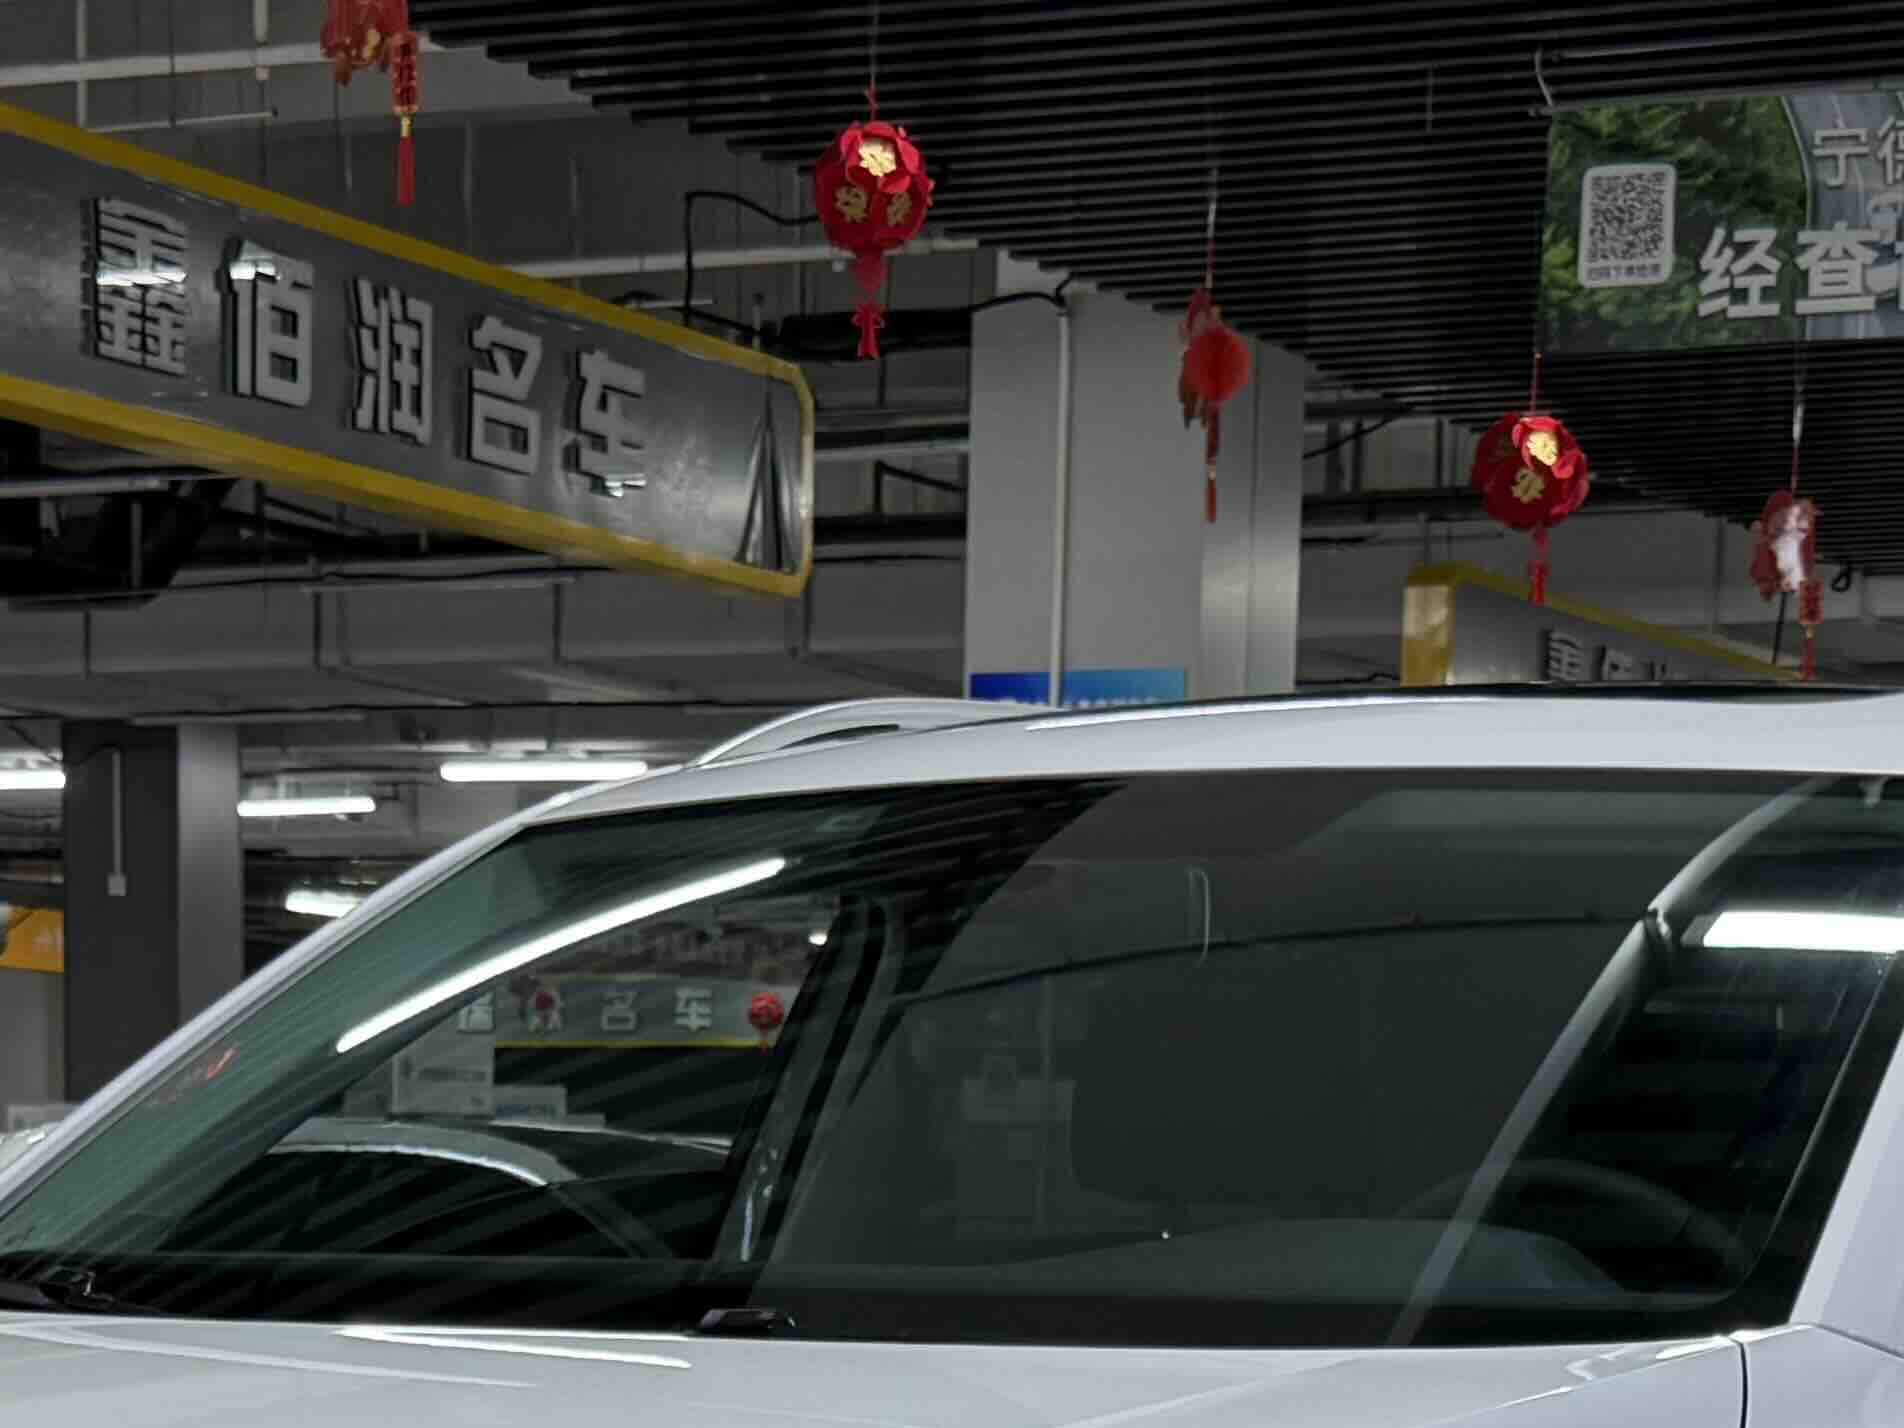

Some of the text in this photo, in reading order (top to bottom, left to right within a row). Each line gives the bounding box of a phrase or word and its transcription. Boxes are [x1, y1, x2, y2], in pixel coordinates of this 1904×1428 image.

[97, 199, 647, 497] 鑫佰润名车
